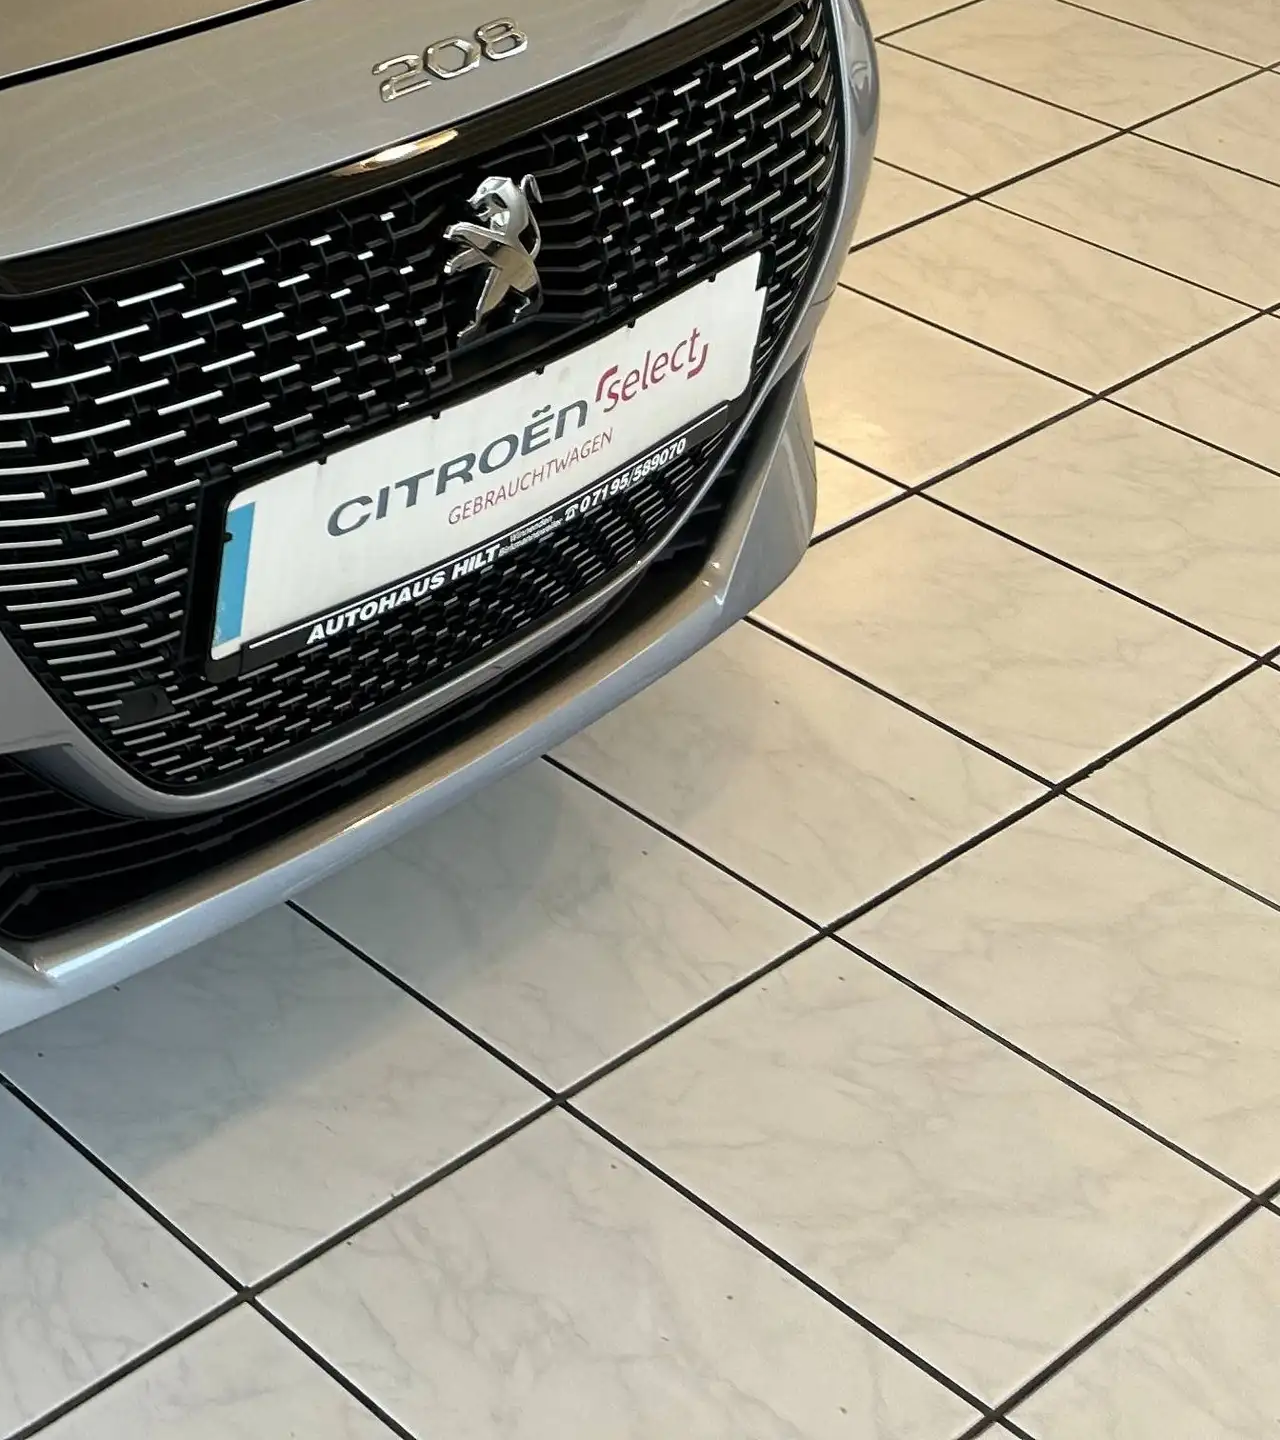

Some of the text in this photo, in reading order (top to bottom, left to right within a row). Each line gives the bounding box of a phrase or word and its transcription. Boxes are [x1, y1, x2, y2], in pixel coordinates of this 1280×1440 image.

[371, 17, 528, 103] 208
[326, 326, 708, 537] CITROËN select
[447, 426, 614, 527] GEBRAUCHTWAGEN
[579, 437, 687, 515] 07195/589070
[306, 543, 502, 645] AUTOHAUS HILT
